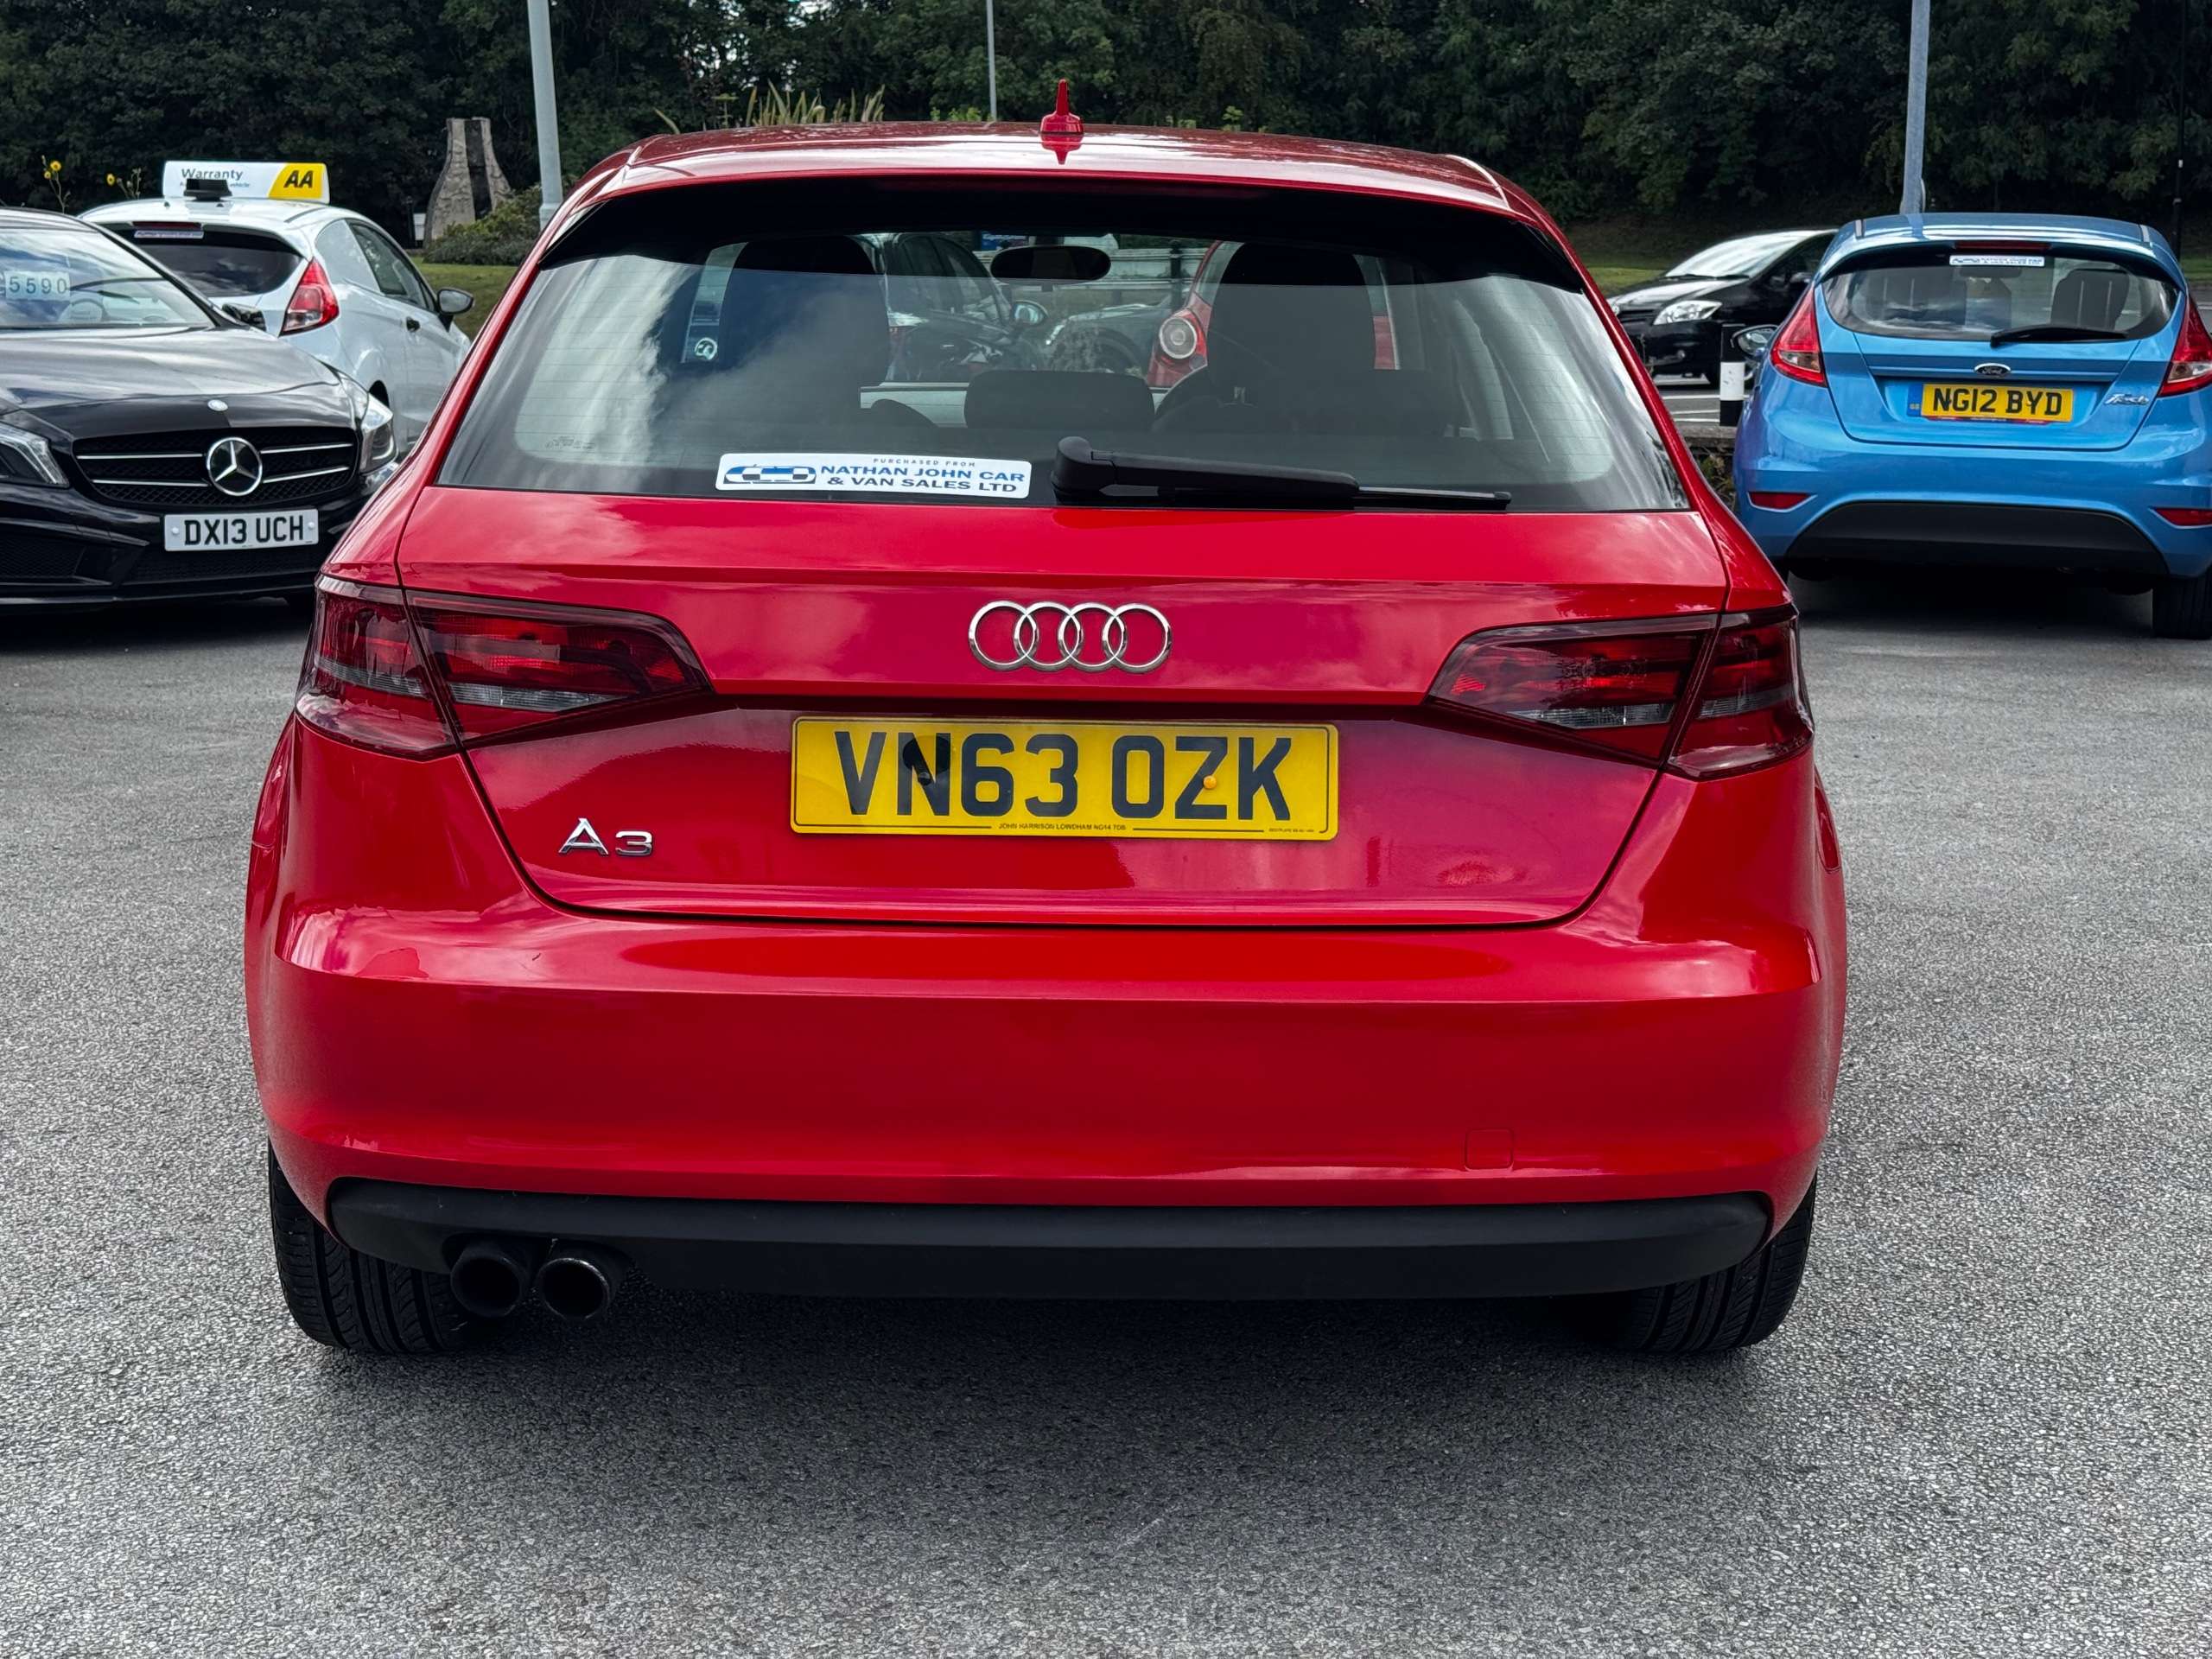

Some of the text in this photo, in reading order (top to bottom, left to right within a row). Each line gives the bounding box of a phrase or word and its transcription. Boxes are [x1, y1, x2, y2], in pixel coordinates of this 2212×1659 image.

[181, 168, 244, 181] Warranty
[283, 169, 315, 188] AA
[9, 276, 67, 295] 5590
[1933, 387, 2063, 416] NG12 BYD
[873, 458, 939, 467] PURCHASED
[820, 466, 1026, 482] NATHAN JOHN CAR
[827, 476, 1017, 493] & VAN SALES LTD
[184, 514, 303, 546] DX13 UCH
[834, 731, 1293, 821] VN63 OZK
[558, 817, 652, 856] A3
